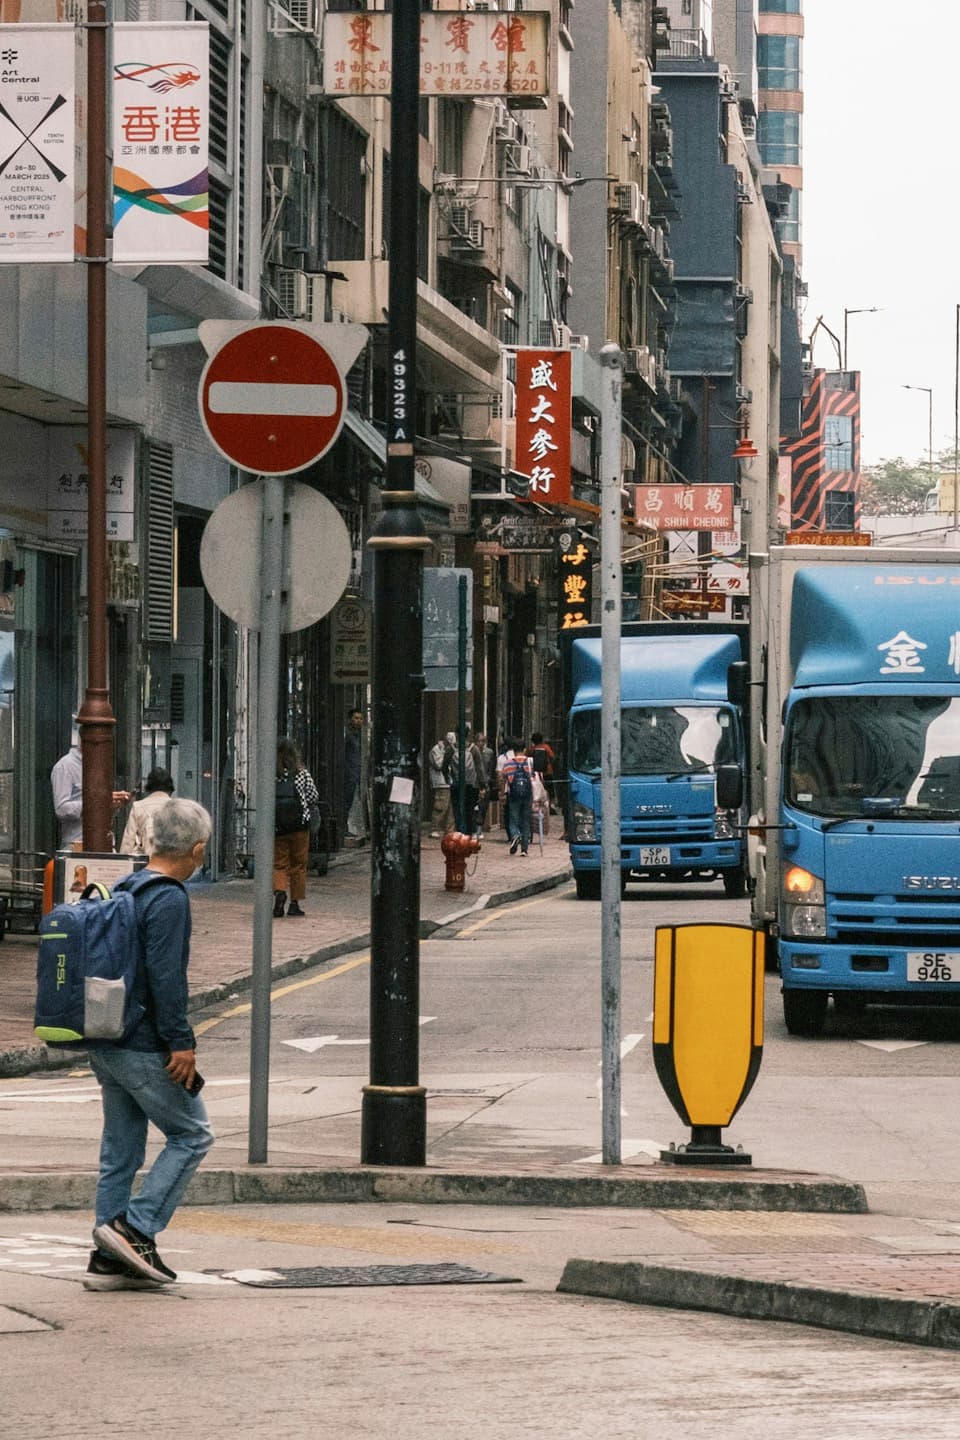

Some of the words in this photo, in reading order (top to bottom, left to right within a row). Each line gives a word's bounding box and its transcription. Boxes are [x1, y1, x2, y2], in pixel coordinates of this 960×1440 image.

[2, 69, 18, 77] Art
[1, 77, 40, 85] Central
[121, 106, 201, 142] 香港
[121, 145, 201, 155] 亞洲國際都會
[10, 185, 44, 193] CENTRAL
[528, 360, 559, 494] 盛大參行
[394, 427, 406, 440] A
[664, 517, 689, 528] SHUN
[693, 517, 729, 528] CHEONG
[643, 856, 668, 865] 7160
[923, 953, 947, 967] SE
[56, 954, 66, 991] RSL
[917, 967, 952, 981] 946
